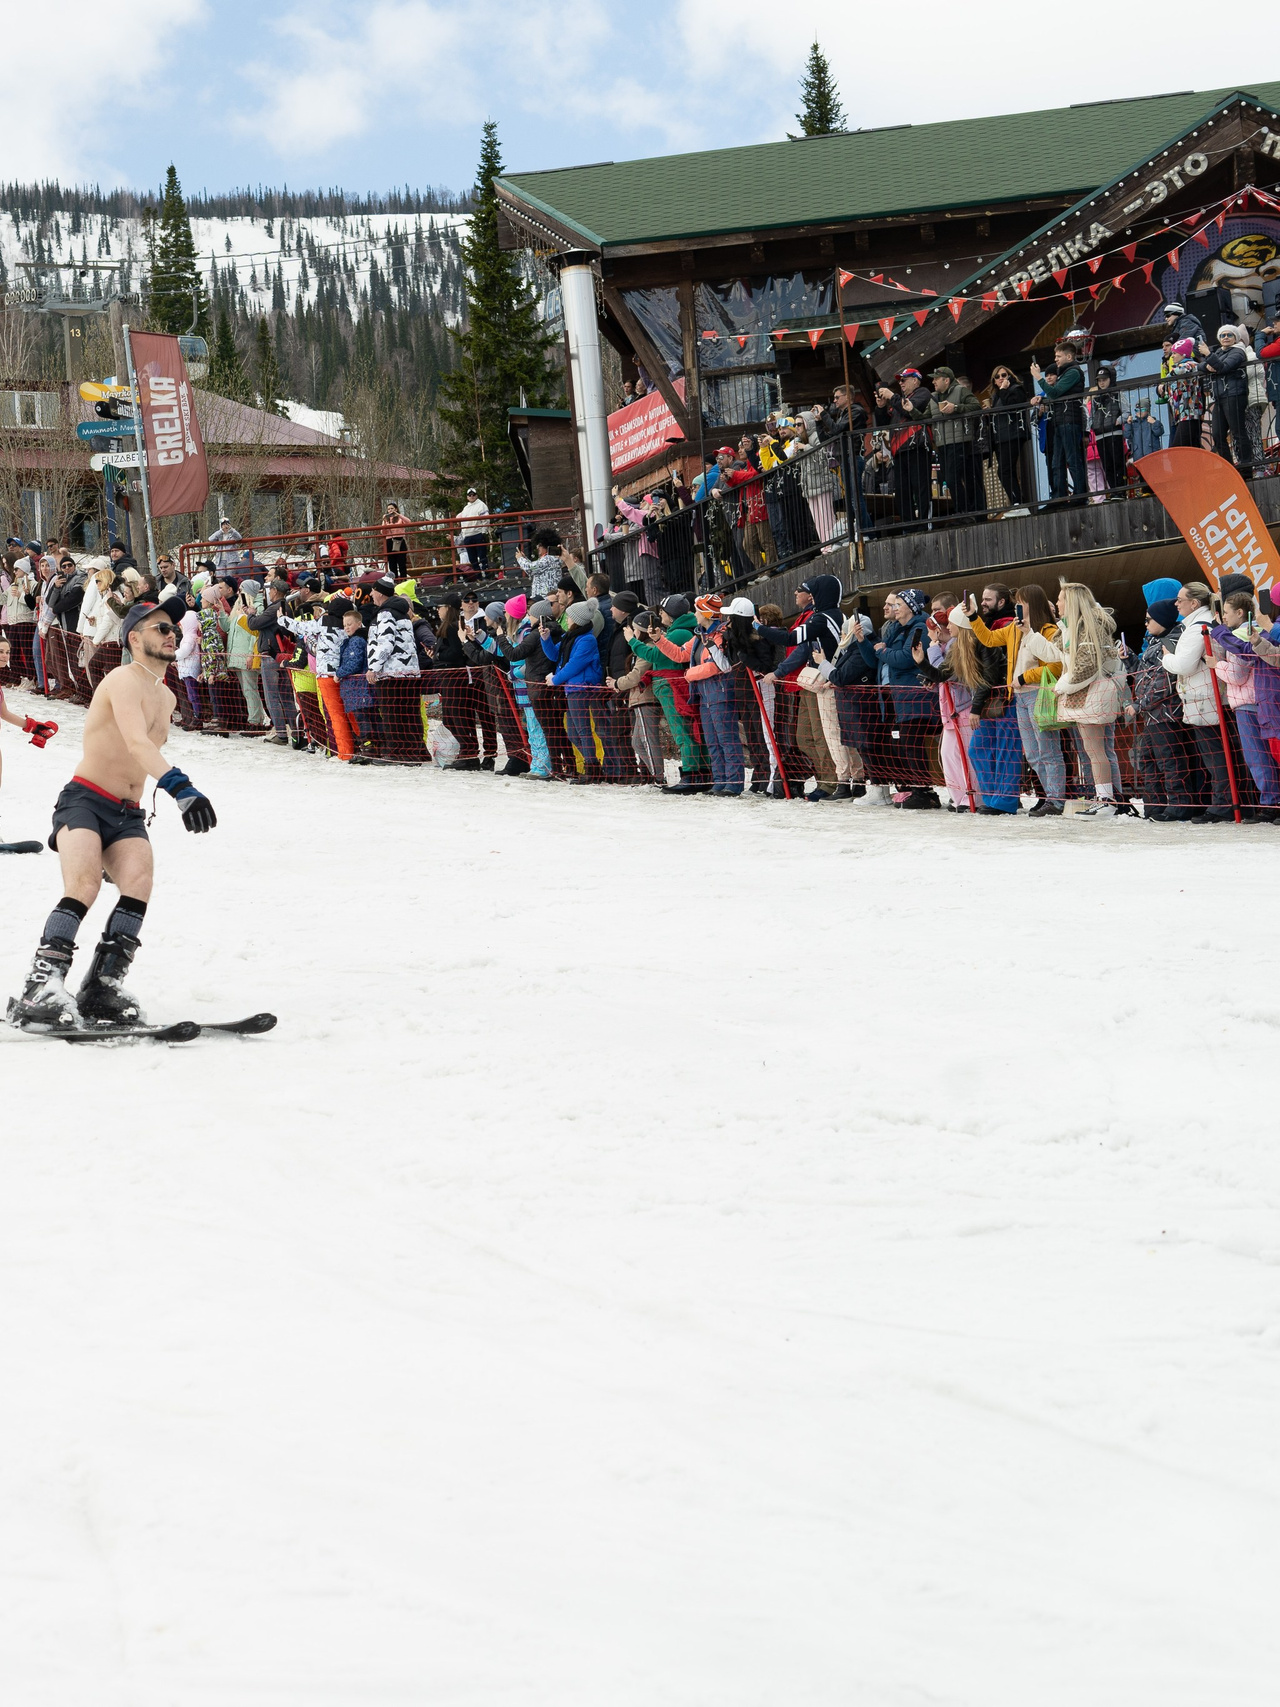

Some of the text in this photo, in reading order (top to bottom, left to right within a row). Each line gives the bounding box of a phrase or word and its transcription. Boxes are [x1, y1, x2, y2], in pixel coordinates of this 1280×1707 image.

[991, 221, 1114, 306] ГРЕЛКА
[70, 329, 81, 337] 13
[149, 376, 184, 466] GRELKA
[658, 414, 677, 431] ШЕРЕГЕ
[81, 425, 118, 435] Mammoth
